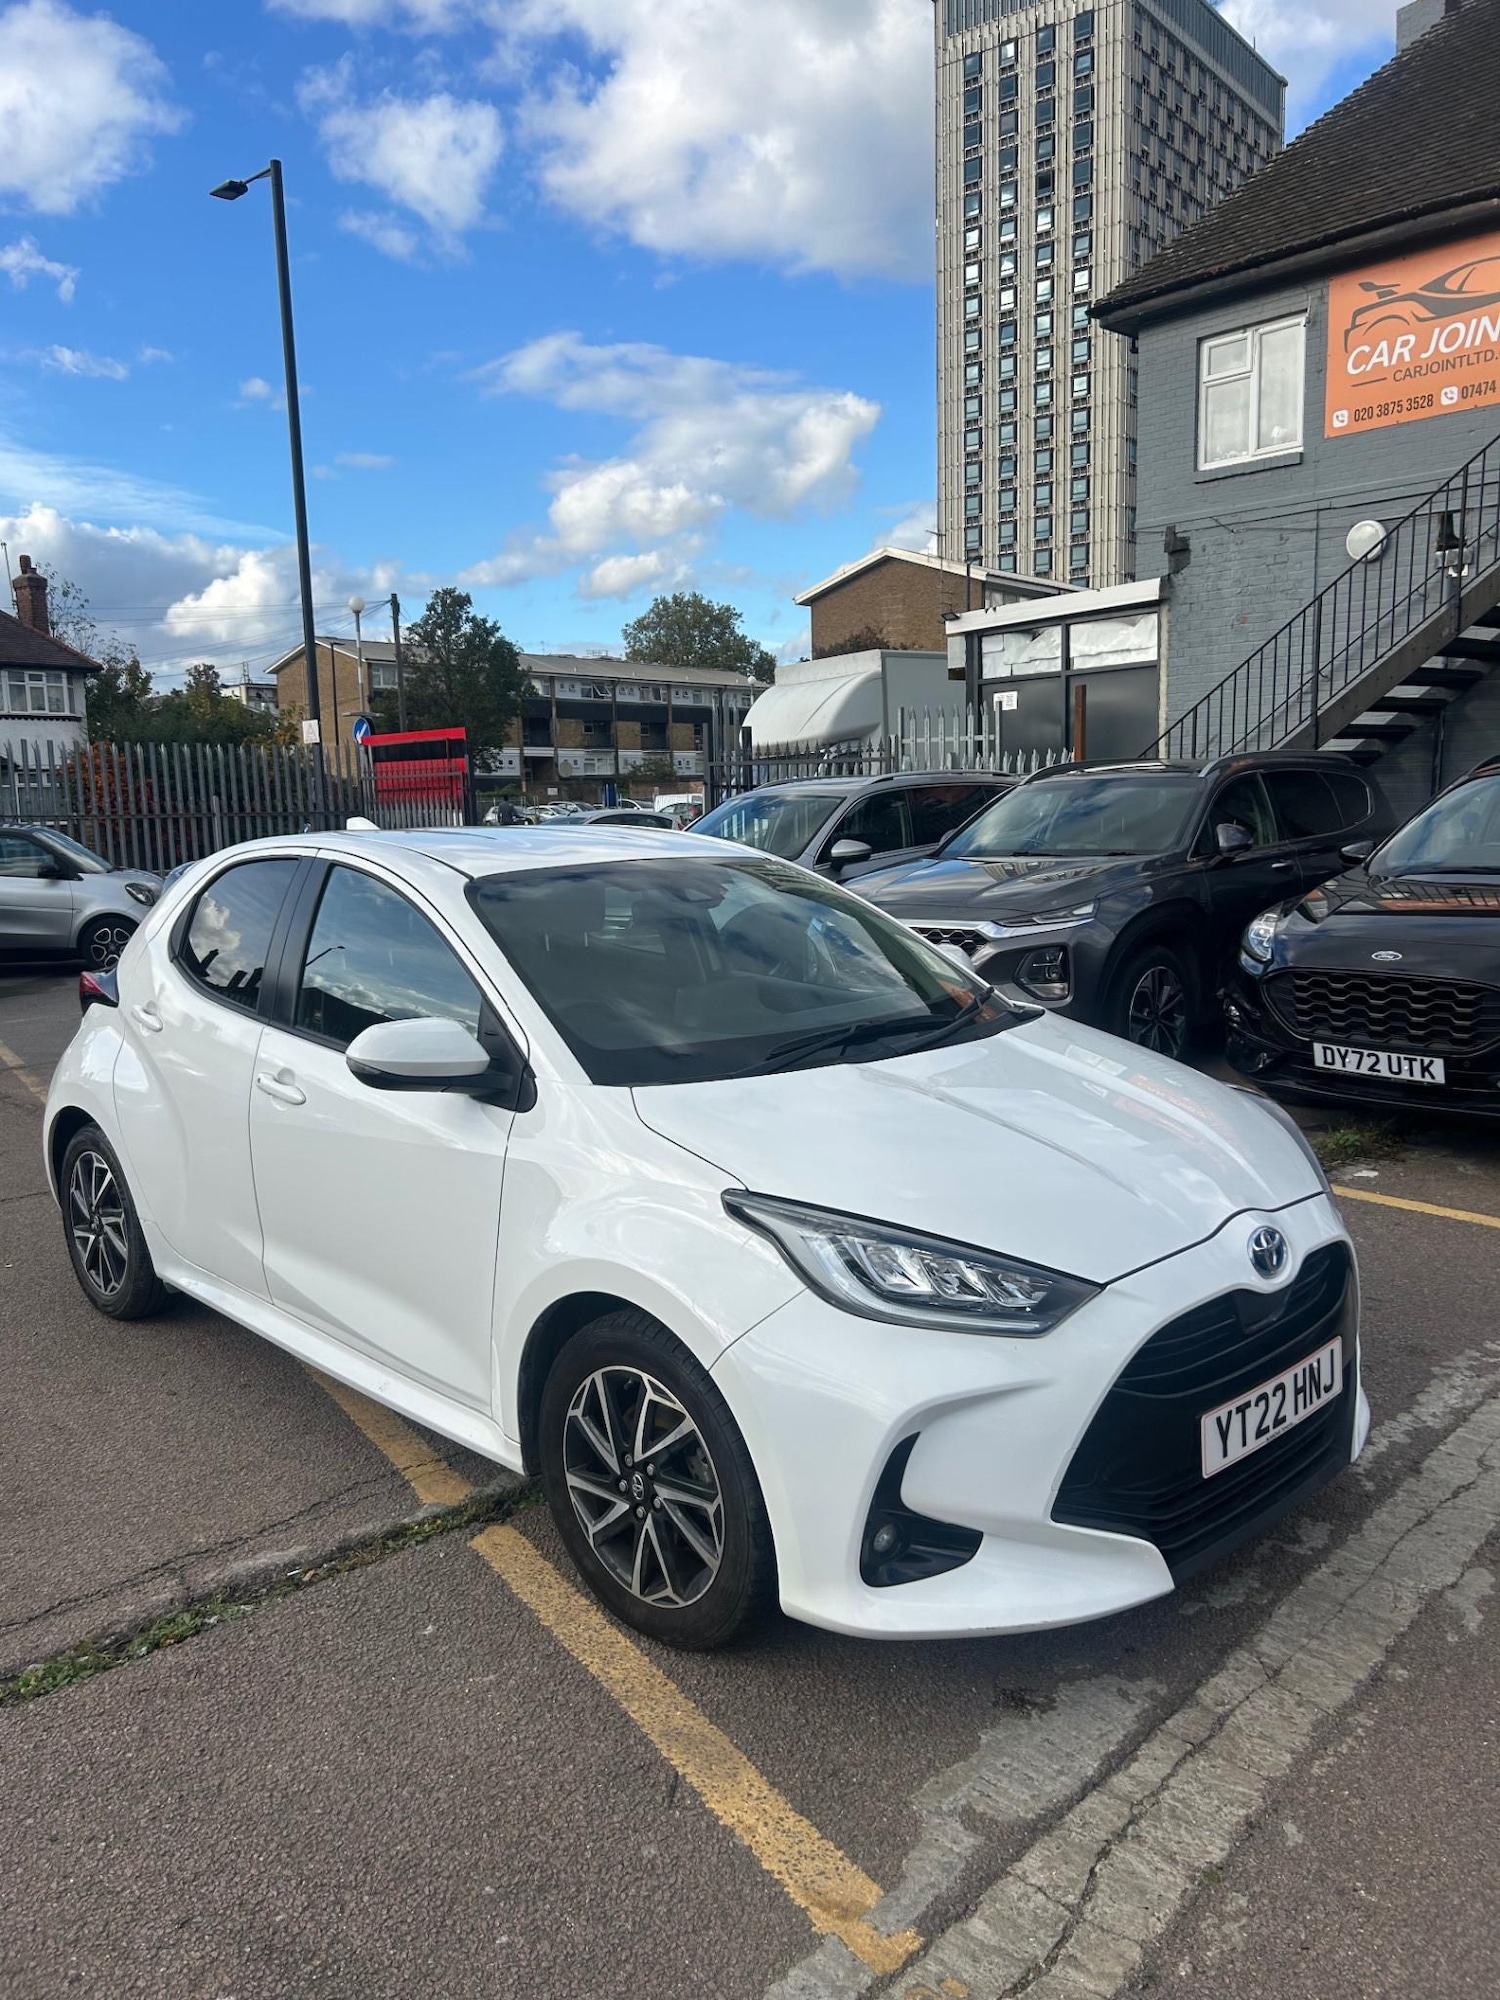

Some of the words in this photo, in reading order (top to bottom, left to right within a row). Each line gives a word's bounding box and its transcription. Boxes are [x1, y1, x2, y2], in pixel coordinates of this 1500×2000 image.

[1347, 333, 1416, 375] CAR
[1420, 311, 1500, 358] JOIN
[1393, 348, 1500, 382] CARJOINTLTD.
[1461, 379, 1497, 399] 07474
[1354, 406, 1374, 422] 020
[1377, 399, 1404, 418] 3875
[1406, 393, 1434, 411] 3528
[1322, 1046, 1382, 1074] DY72
[1387, 1055, 1436, 1080] UTK
[1216, 1382, 1287, 1459] YT22
[1293, 1348, 1335, 1416] HNJ
